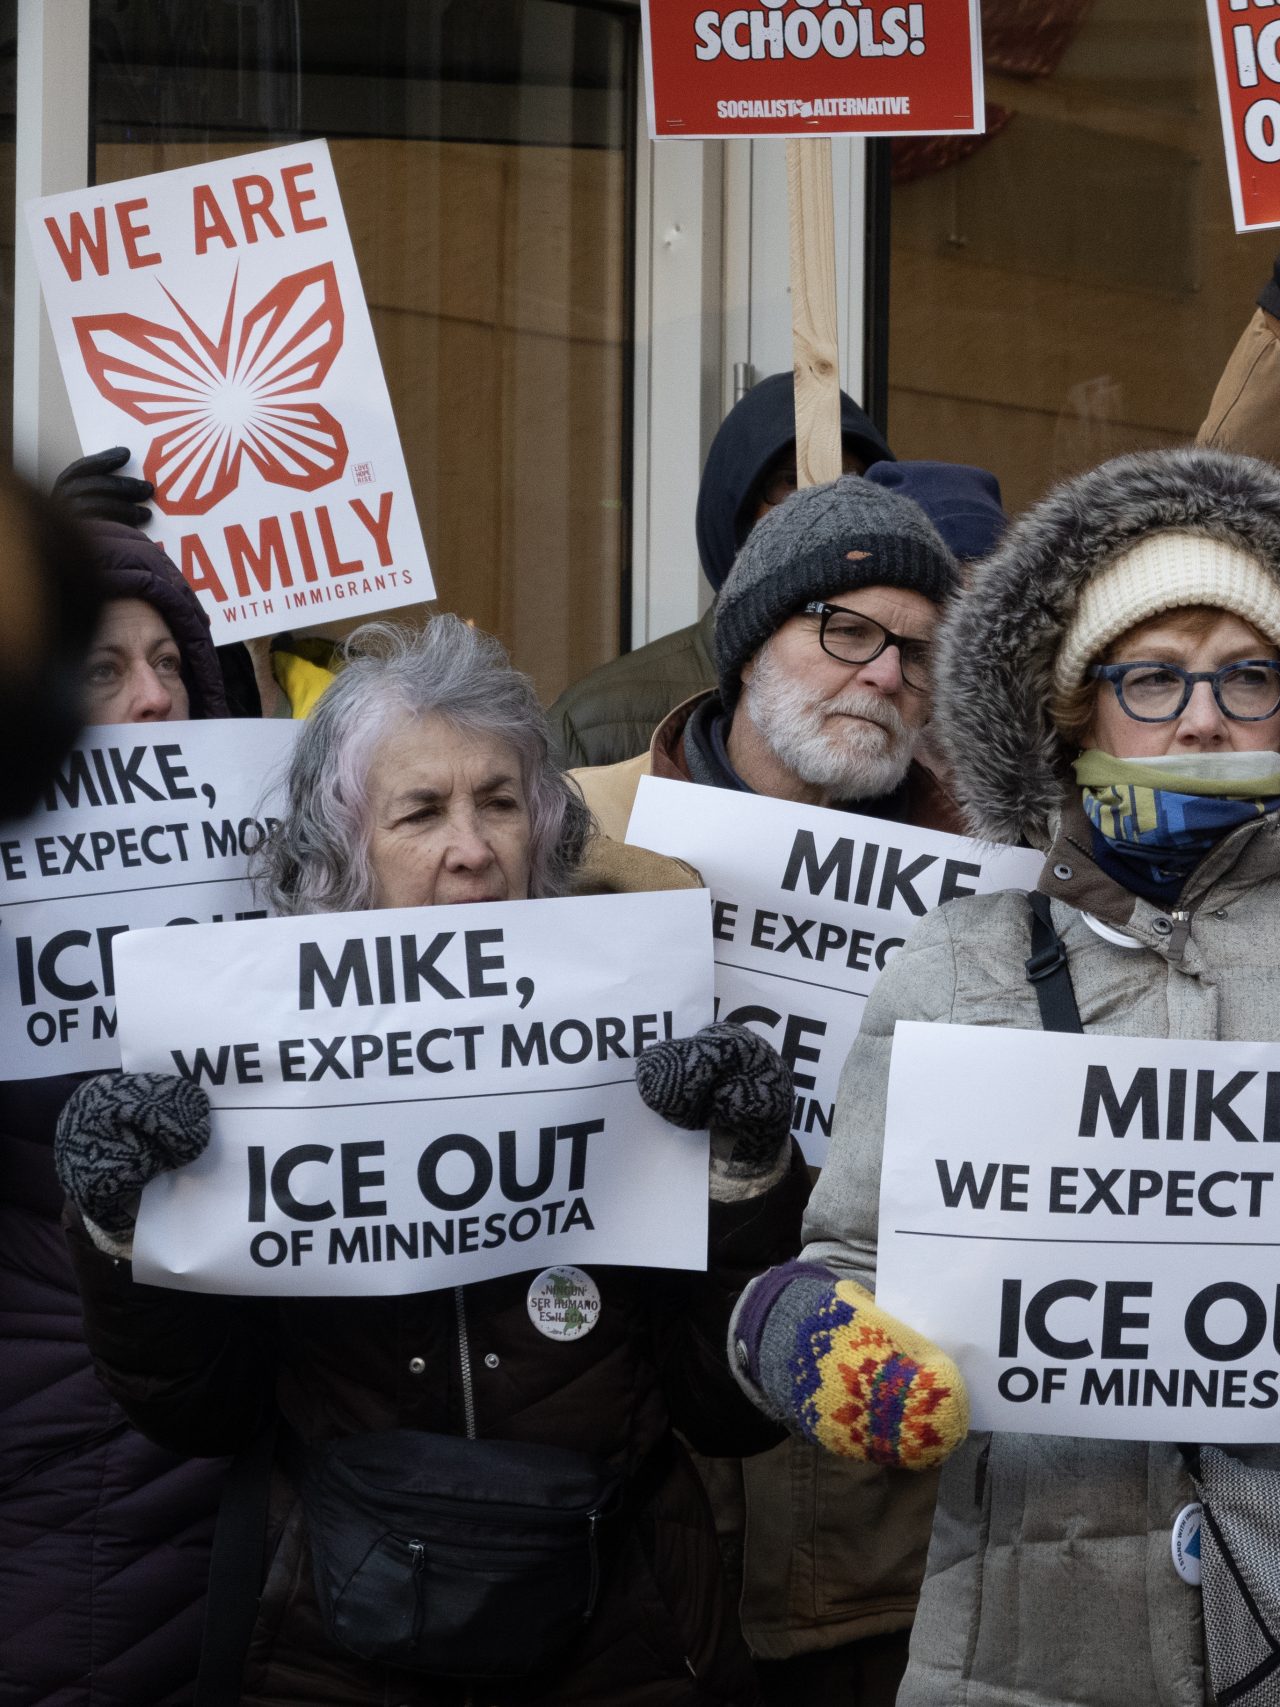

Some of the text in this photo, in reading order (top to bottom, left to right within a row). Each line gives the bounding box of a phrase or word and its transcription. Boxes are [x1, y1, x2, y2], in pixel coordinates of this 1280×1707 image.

[694, 3, 926, 61] SCHOOLS!
[716, 97, 910, 118] SOCIALIST ALTERNATIVE
[44, 162, 327, 282] WE ARE
[156, 491, 394, 603] AMILY
[223, 569, 413, 623] WITH IMMIGRANTS
[46, 743, 216, 810] MIKE,
[35, 823, 189, 877] EXPECT
[298, 928, 536, 1011] MIKE,
[26, 1007, 79, 1047] OF
[170, 1043, 264, 1086] WE
[279, 1026, 486, 1083] EXPECT
[500, 1010, 674, 1069] MORE!
[246, 1118, 605, 1224] ICE OUT
[934, 1159, 1030, 1213] WE
[1048, 1165, 1274, 1218] EXPECT
[249, 1197, 596, 1269] OF MINNESOTA
[531, 1298, 598, 1311] SER HUMANO
[540, 1311, 552, 1322] ES
[998, 1278, 1154, 1362] ICE
[997, 1366, 1067, 1406] OF
